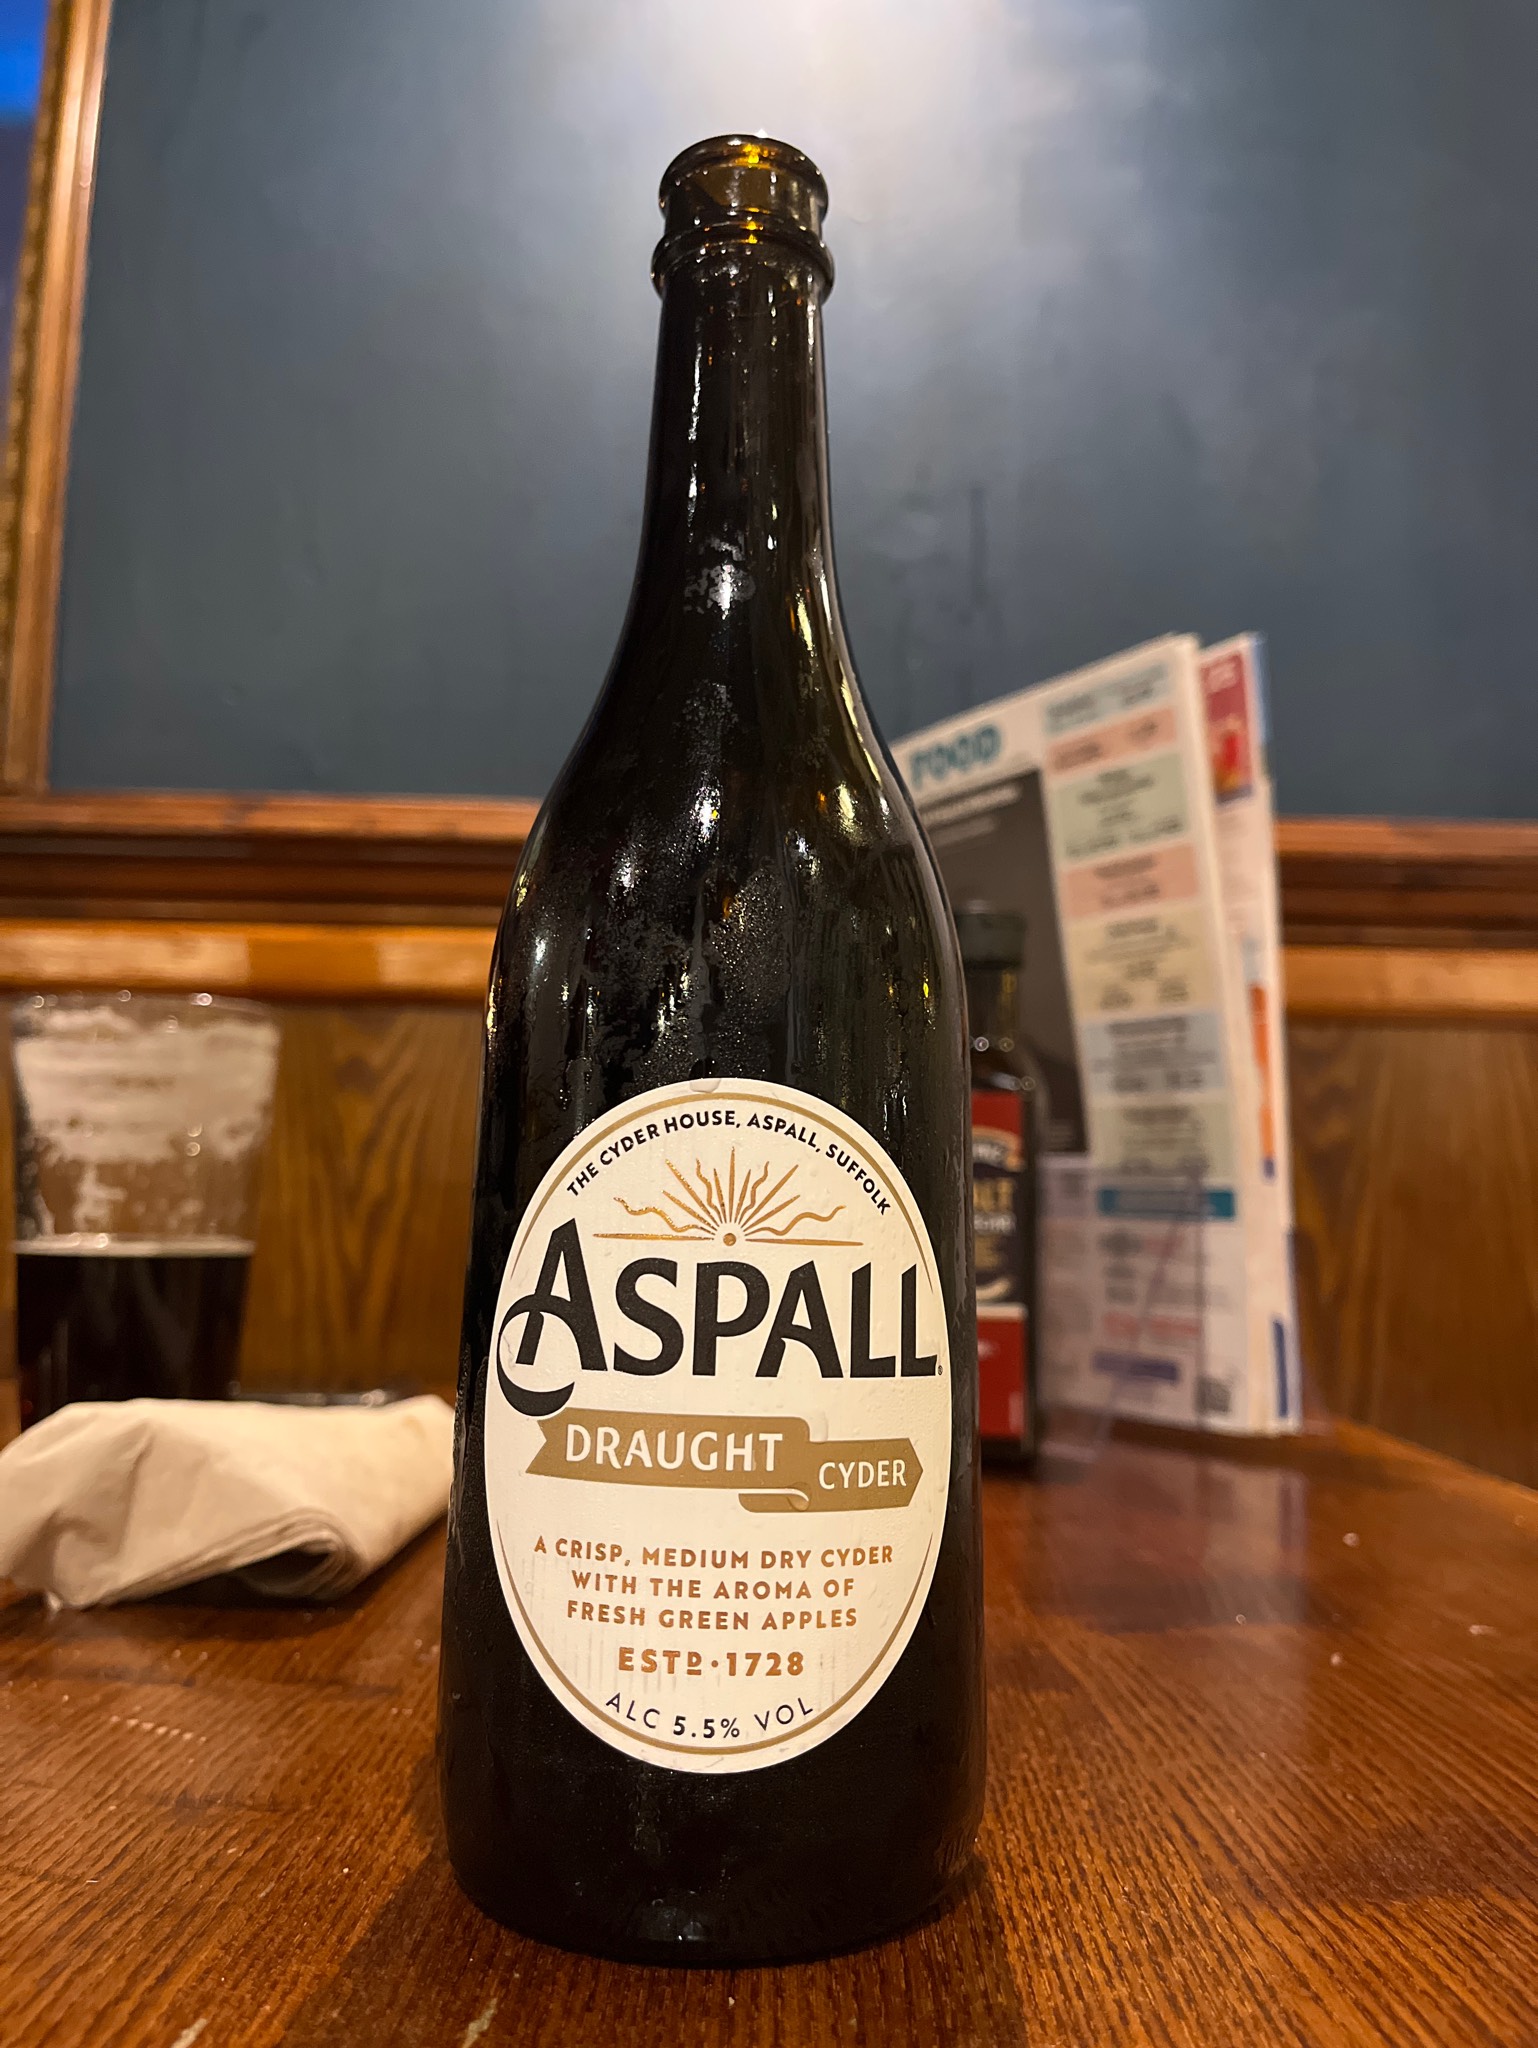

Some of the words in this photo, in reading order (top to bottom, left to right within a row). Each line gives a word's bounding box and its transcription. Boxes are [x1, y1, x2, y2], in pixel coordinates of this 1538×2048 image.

[566, 1166, 600, 1197] THE
[600, 1124, 660, 1165] CYDER
[664, 1111, 740, 1133] HOUSE,
[747, 1113, 820, 1152] ASPALL,
[826, 1144, 890, 1215] SUFFOLK
[567, 1424, 782, 1471] DRAUGHT
[819, 1460, 906, 1489] CYDER
[534, 1536, 546, 1553] A
[556, 1538, 630, 1566] CRISP,
[643, 1547, 748, 1568] MEDIUM
[761, 1550, 811, 1569] DRY
[821, 1546, 892, 1567] CYDER
[572, 1570, 636, 1594] WITH
[650, 1578, 701, 1598] THE
[714, 1581, 811, 1599] AROMA
[824, 1578, 854, 1597] OF
[568, 1600, 645, 1626] FRESH
[659, 1610, 748, 1630] GREEN
[762, 1608, 856, 1630] APPLES
[606, 1693, 660, 1729] ALC
[673, 1716, 739, 1738] 5.5%
[754, 1698, 813, 1731] VOL
